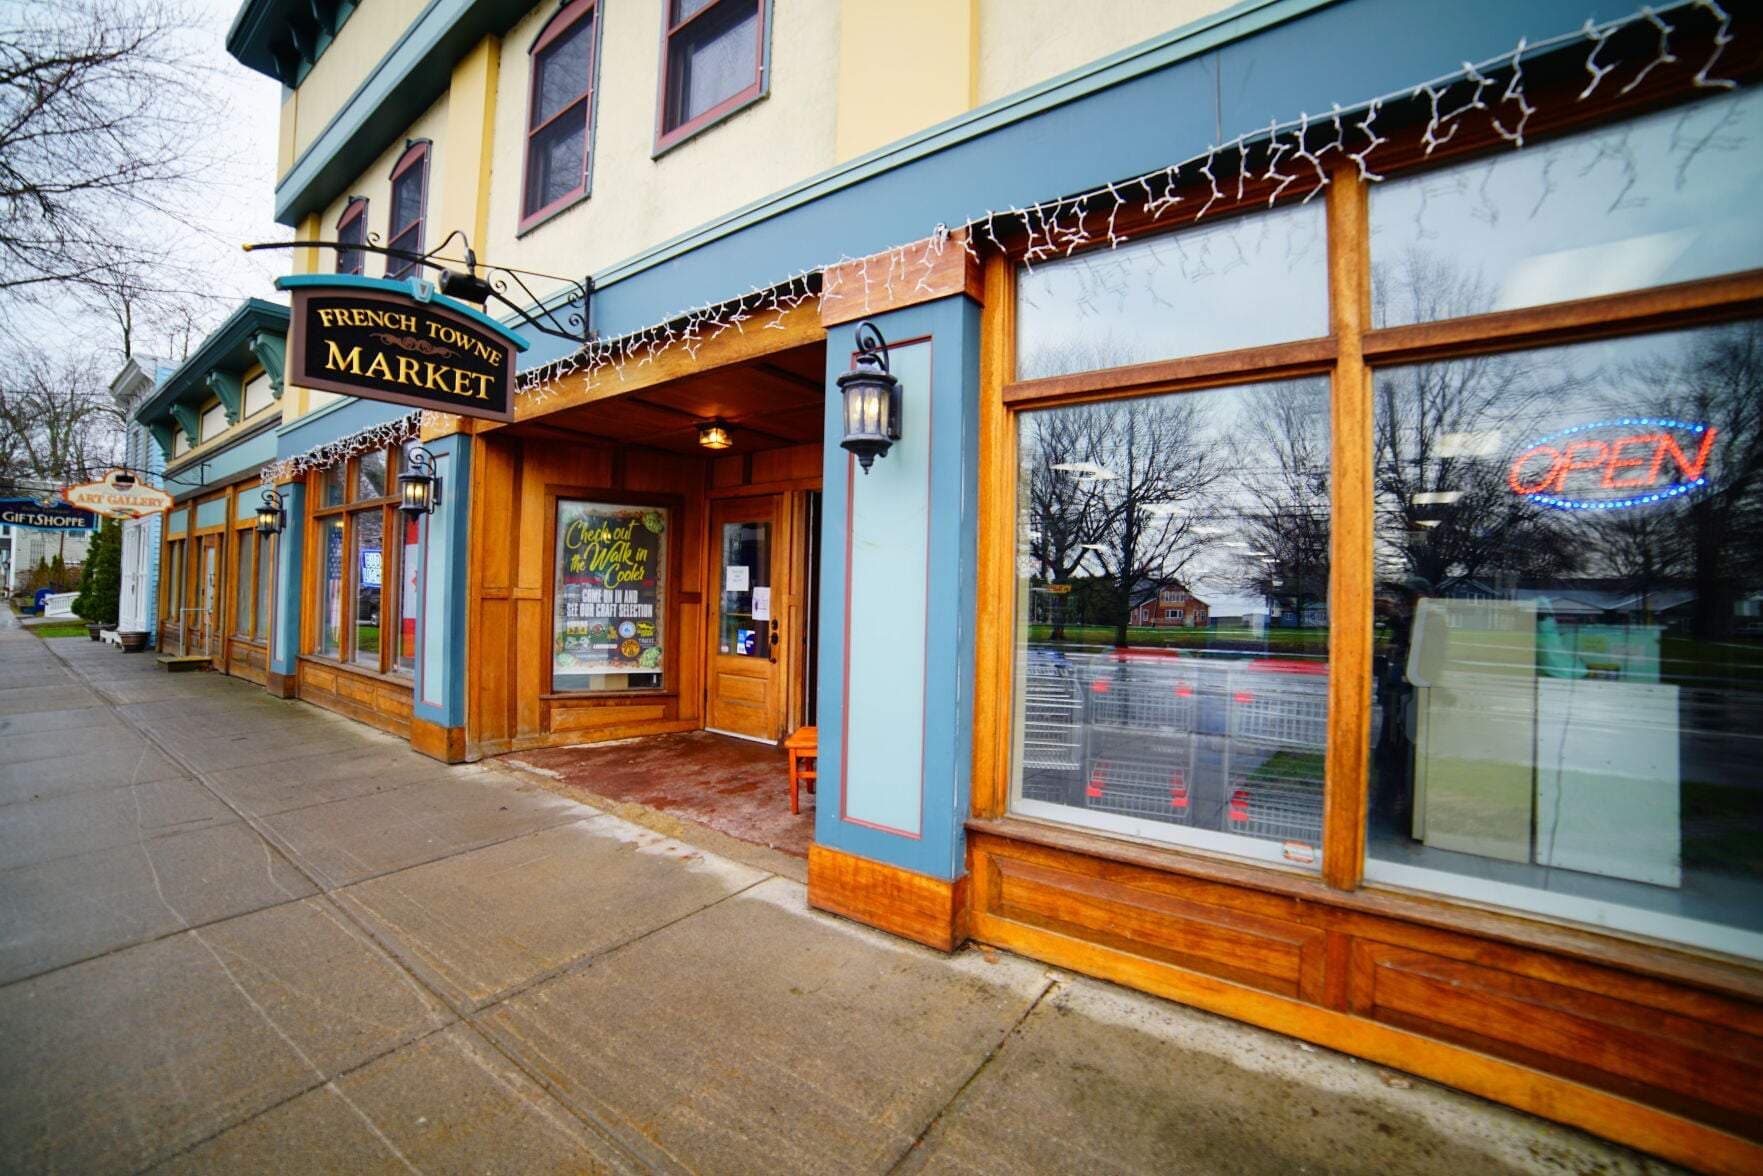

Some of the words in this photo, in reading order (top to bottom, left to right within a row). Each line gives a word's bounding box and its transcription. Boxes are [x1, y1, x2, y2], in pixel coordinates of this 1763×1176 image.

[317, 308, 417, 333] FRENCH
[425, 320, 502, 367] TOWNE
[324, 340, 495, 400] MARKET
[1507, 427, 1718, 495] OPEN
[565, 519, 612, 550] Check
[613, 522, 640, 542] out
[570, 554, 586, 573] the
[584, 540, 634, 572] Walk
[635, 546, 648, 562] in
[604, 563, 645, 590] Cooler
